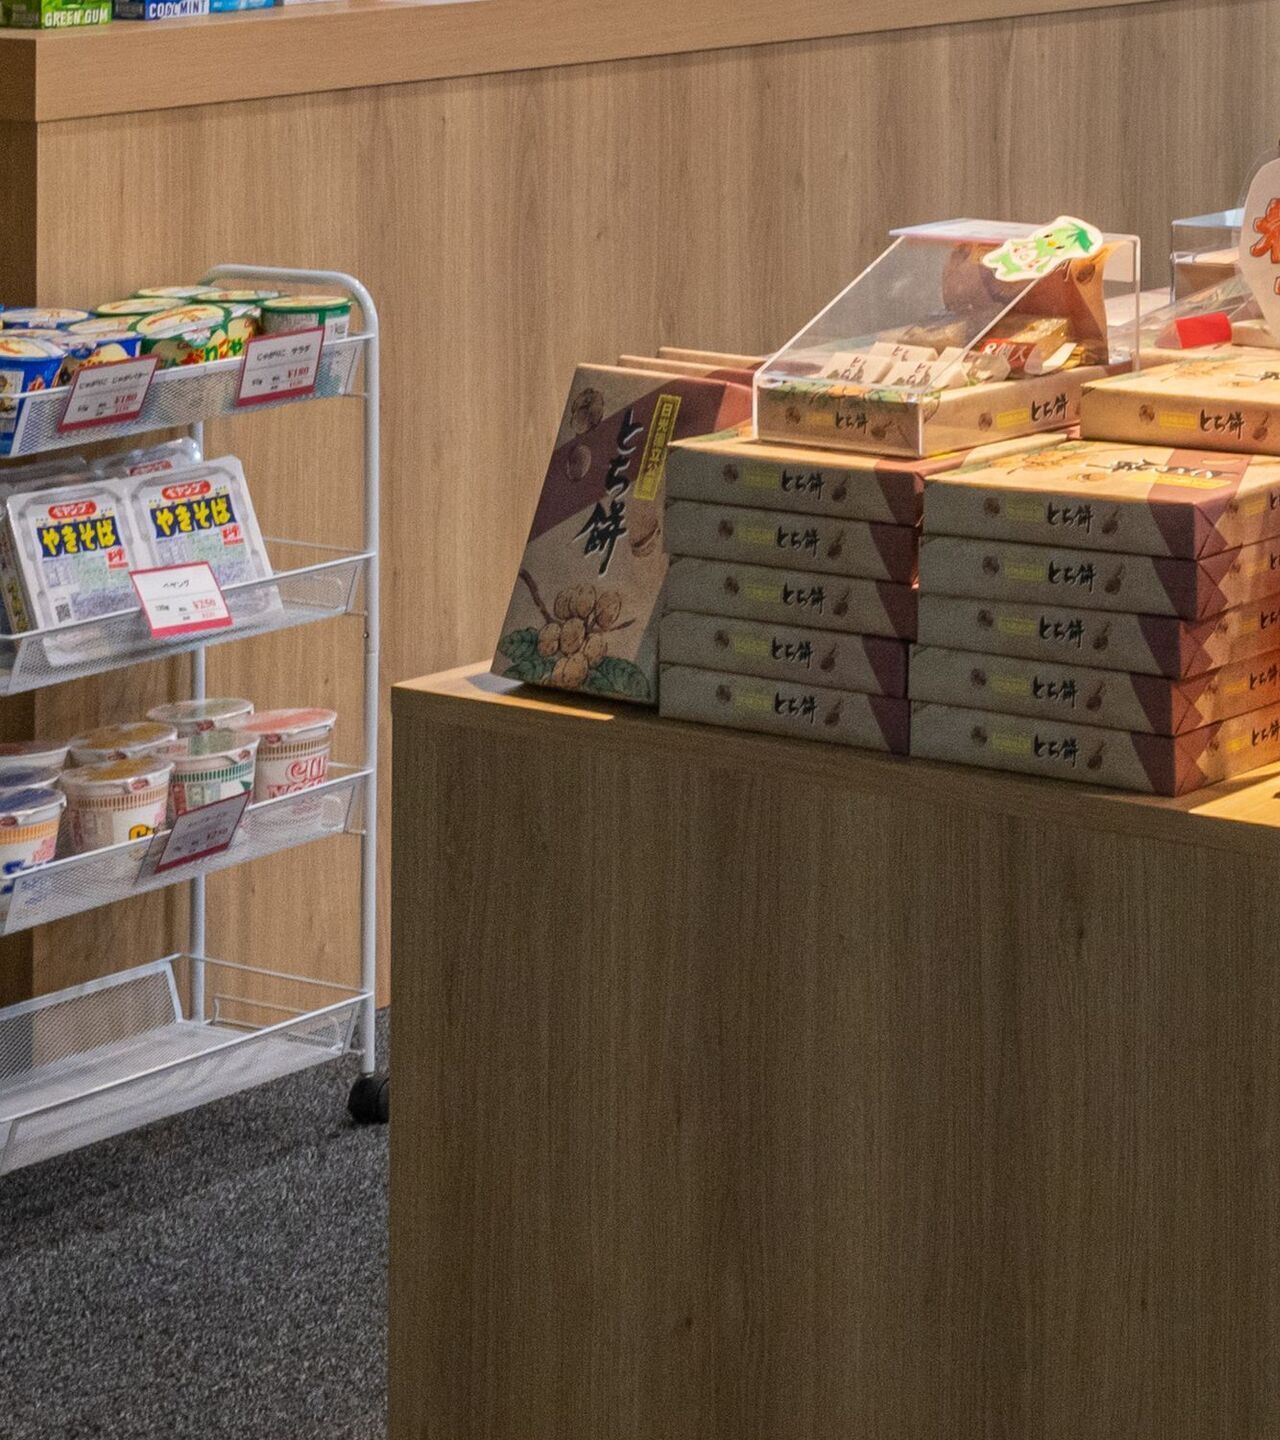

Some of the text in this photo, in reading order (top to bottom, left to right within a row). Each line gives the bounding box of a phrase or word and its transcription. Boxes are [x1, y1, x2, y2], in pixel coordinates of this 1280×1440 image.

[44, 7, 109, 28] GREEN GUM
[1031, 393, 1070, 423] とち餅
[1199, 409, 1246, 443] とち餅
[573, 408, 644, 577] とち餅
[780, 468, 825, 500] とち餅
[51, 503, 91, 517] ペヤング
[155, 496, 231, 537] やきそば
[1046, 502, 1094, 534] とち餅
[42, 518, 117, 557] やきそば
[776, 526, 820, 558] とち餅
[1048, 561, 1097, 594] とち餅
[782, 582, 825, 614] とち餅
[1038, 615, 1086, 648] とち餅
[771, 636, 814, 669] とち餅
[774, 691, 817, 725] とち餅
[1032, 676, 1079, 710] とち餅
[1033, 734, 1079, 769] とち餅
